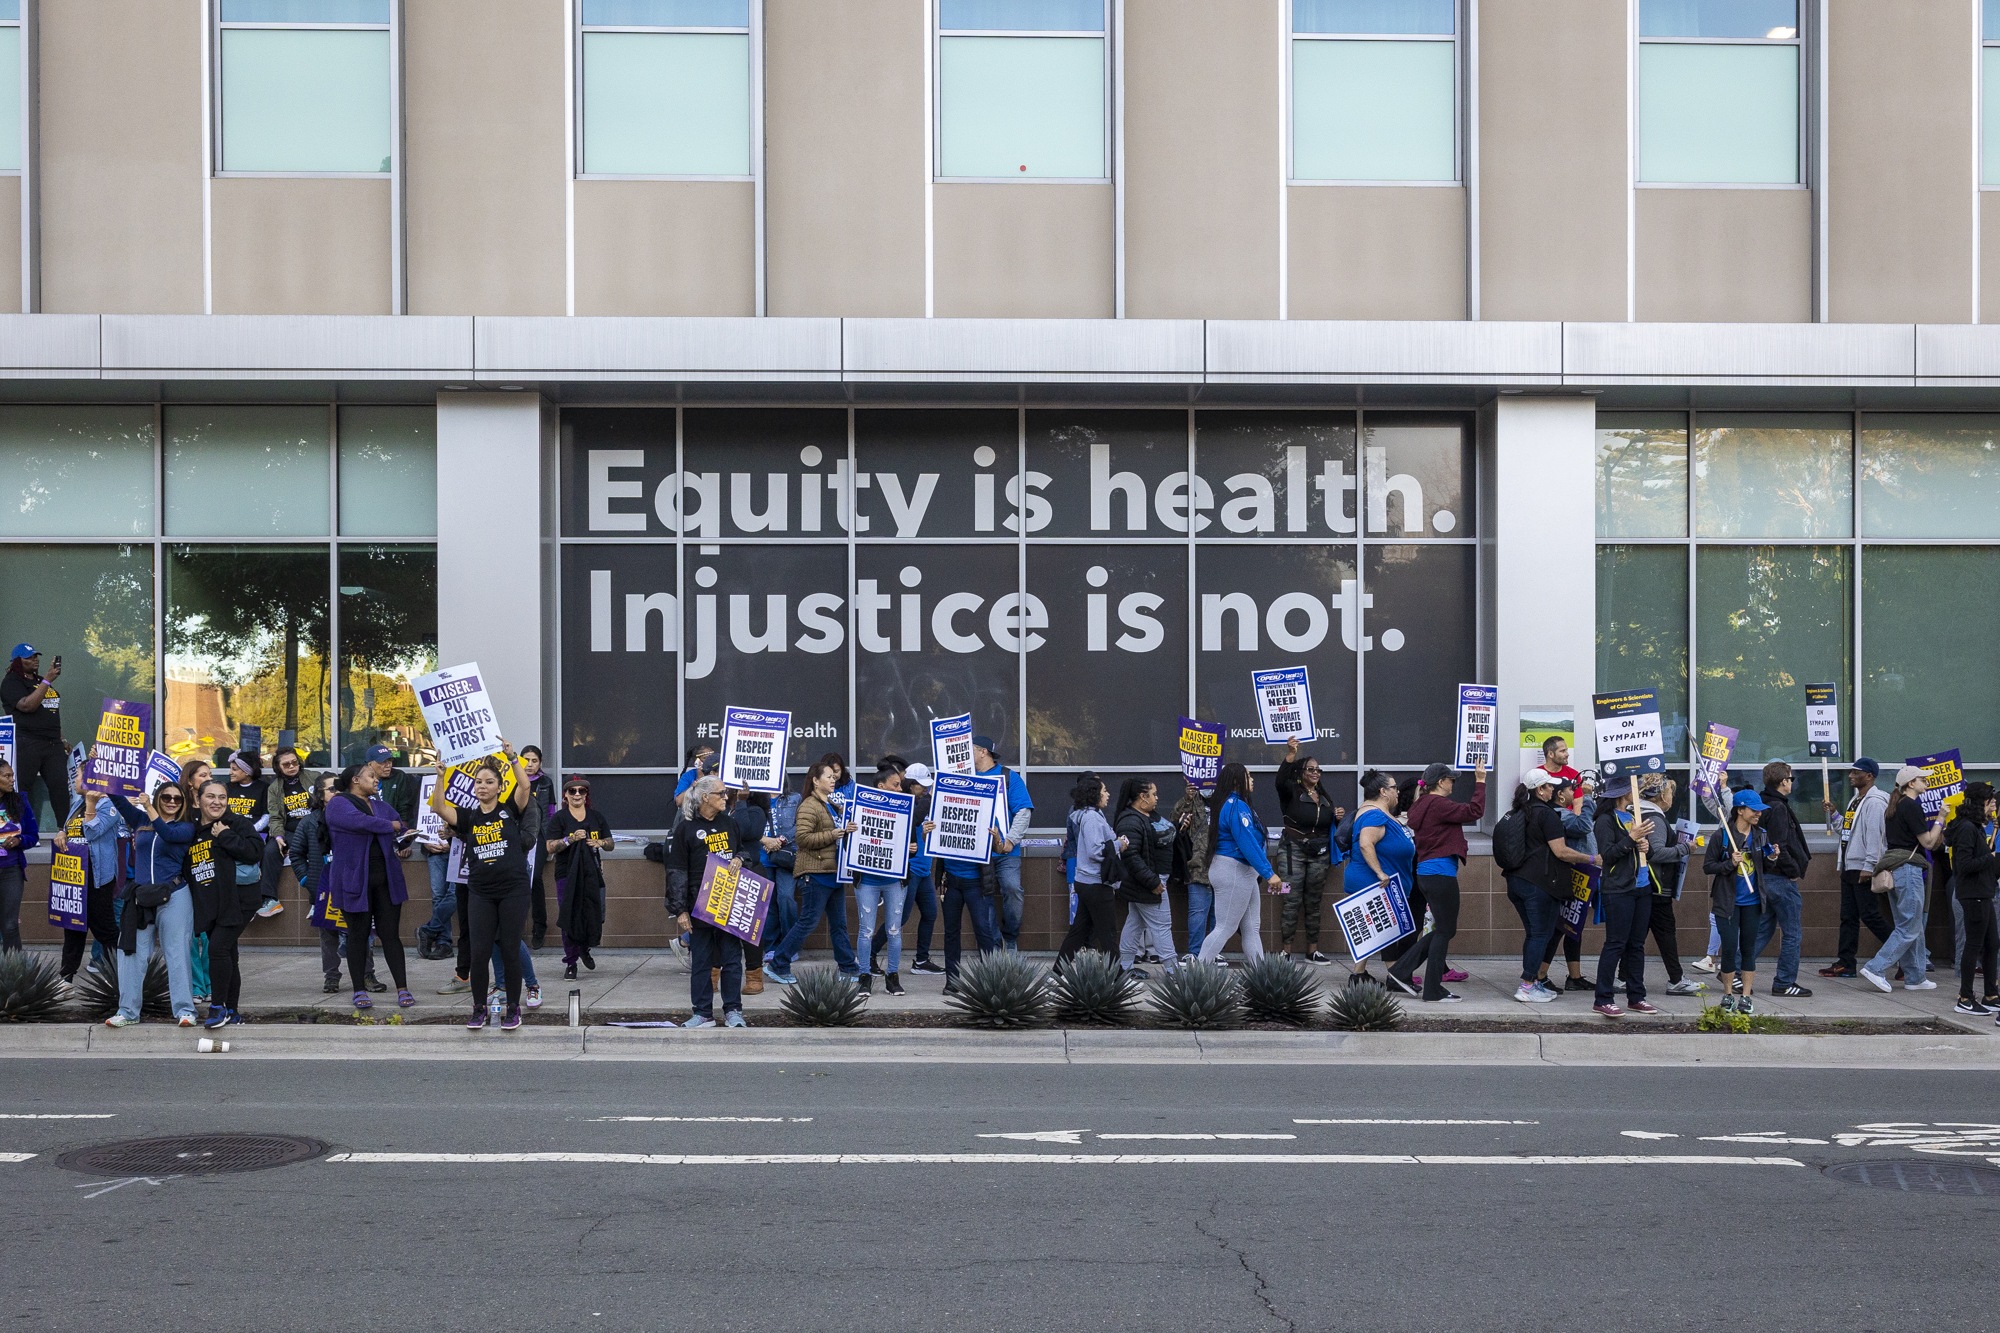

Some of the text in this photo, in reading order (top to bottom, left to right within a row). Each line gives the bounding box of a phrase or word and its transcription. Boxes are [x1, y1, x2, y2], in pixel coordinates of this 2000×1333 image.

[589, 444, 1456, 555] Equity is health.
[591, 566, 1404, 679] Injustice is not.
[428, 680, 474, 703] KAISER:
[1266, 688, 1296, 698] PATIENT
[1597, 697, 1623, 705] Engineers
[1628, 693, 1654, 701] Scientists
[443, 696, 469, 717] PUT
[1268, 696, 1297, 706] NEED
[104, 714, 134, 731] KAISER
[433, 708, 491, 738] PATIENTS
[734, 713, 761, 721] OPEIU
[1270, 711, 1301, 723] CORPORATE
[1468, 713, 1490, 724] PATIENT
[1622, 720, 1634, 728] ON
[738, 729, 759, 737] SYMPATHY
[939, 722, 961, 731] OPEIU
[1231, 728, 1264, 738] KAISER
[1272, 721, 1303, 733] GREED
[1468, 723, 1489, 733] NEED
[99, 727, 140, 745] WORKERS
[448, 726, 485, 750] FIRST
[1185, 730, 1213, 744] KAISER
[1602, 730, 1655, 742] SYMPATHY
[96, 744, 125, 763] WON'T
[125, 748, 140, 765] BE
[736, 739, 774, 755] RESPECT
[946, 740, 970, 754] PATIENT
[1181, 739, 1219, 755] WORKERS
[1615, 744, 1647, 753] STRIKE!
[449, 754, 464, 763] STRIKE
[734, 754, 771, 767] HEALTHCARE
[947, 752, 970, 765] NEED
[1180, 751, 1218, 768] WON'T BE
[93, 758, 140, 780] SILENCED
[734, 767, 770, 781] WORKERS
[1709, 760, 1722, 773] BE
[453, 773, 473, 788] ON
[943, 777, 969, 786] OPEIU
[973, 780, 986, 788] Local
[986, 782, 995, 792] 29
[445, 786, 480, 811] STRIK
[862, 792, 884, 801] OPEIU
[900, 800, 909, 808] 29
[1919, 783, 1962, 802] WON'T BE
[228, 797, 256, 808] RESPECT
[943, 795, 981, 806] SYMPATHY STRIKE
[862, 808, 896, 819] SYMPATHY STRIKE
[942, 805, 979, 823] RESPECT
[472, 819, 504, 834] RESPECT
[861, 815, 896, 830] PATIENT
[940, 821, 977, 836] HEALTHCARE
[476, 830, 503, 845] VALUE
[704, 831, 729, 845] PATIENT
[861, 826, 893, 840] NEED
[189, 840, 213, 855] PATIENT
[473, 840, 508, 854] HEALTHCARE
[708, 840, 729, 853] NEED
[939, 834, 975, 851] WORKERS
[192, 850, 210, 863] NEED
[477, 849, 505, 860] WORKERS
[858, 843, 893, 859] CORPORATE
[57, 855, 78, 869] KAISER
[857, 855, 892, 870] GREED
[52, 867, 82, 883] WORKERS
[195, 869, 215, 882] GREED
[52, 882, 82, 900] WON'T BE
[708, 871, 727, 910] KAISER
[1391, 884, 1404, 910] OPEIU
[51, 896, 83, 915] SILENCED
[727, 874, 751, 927] WON'T BE
[738, 880, 761, 934] SILENCED
[1365, 913, 1373, 926] NOT
[1366, 900, 1384, 933] NEED
[1373, 895, 1393, 930] PATIENT
[1343, 910, 1364, 947] GREED
[1352, 906, 1372, 942] CORPORATE
